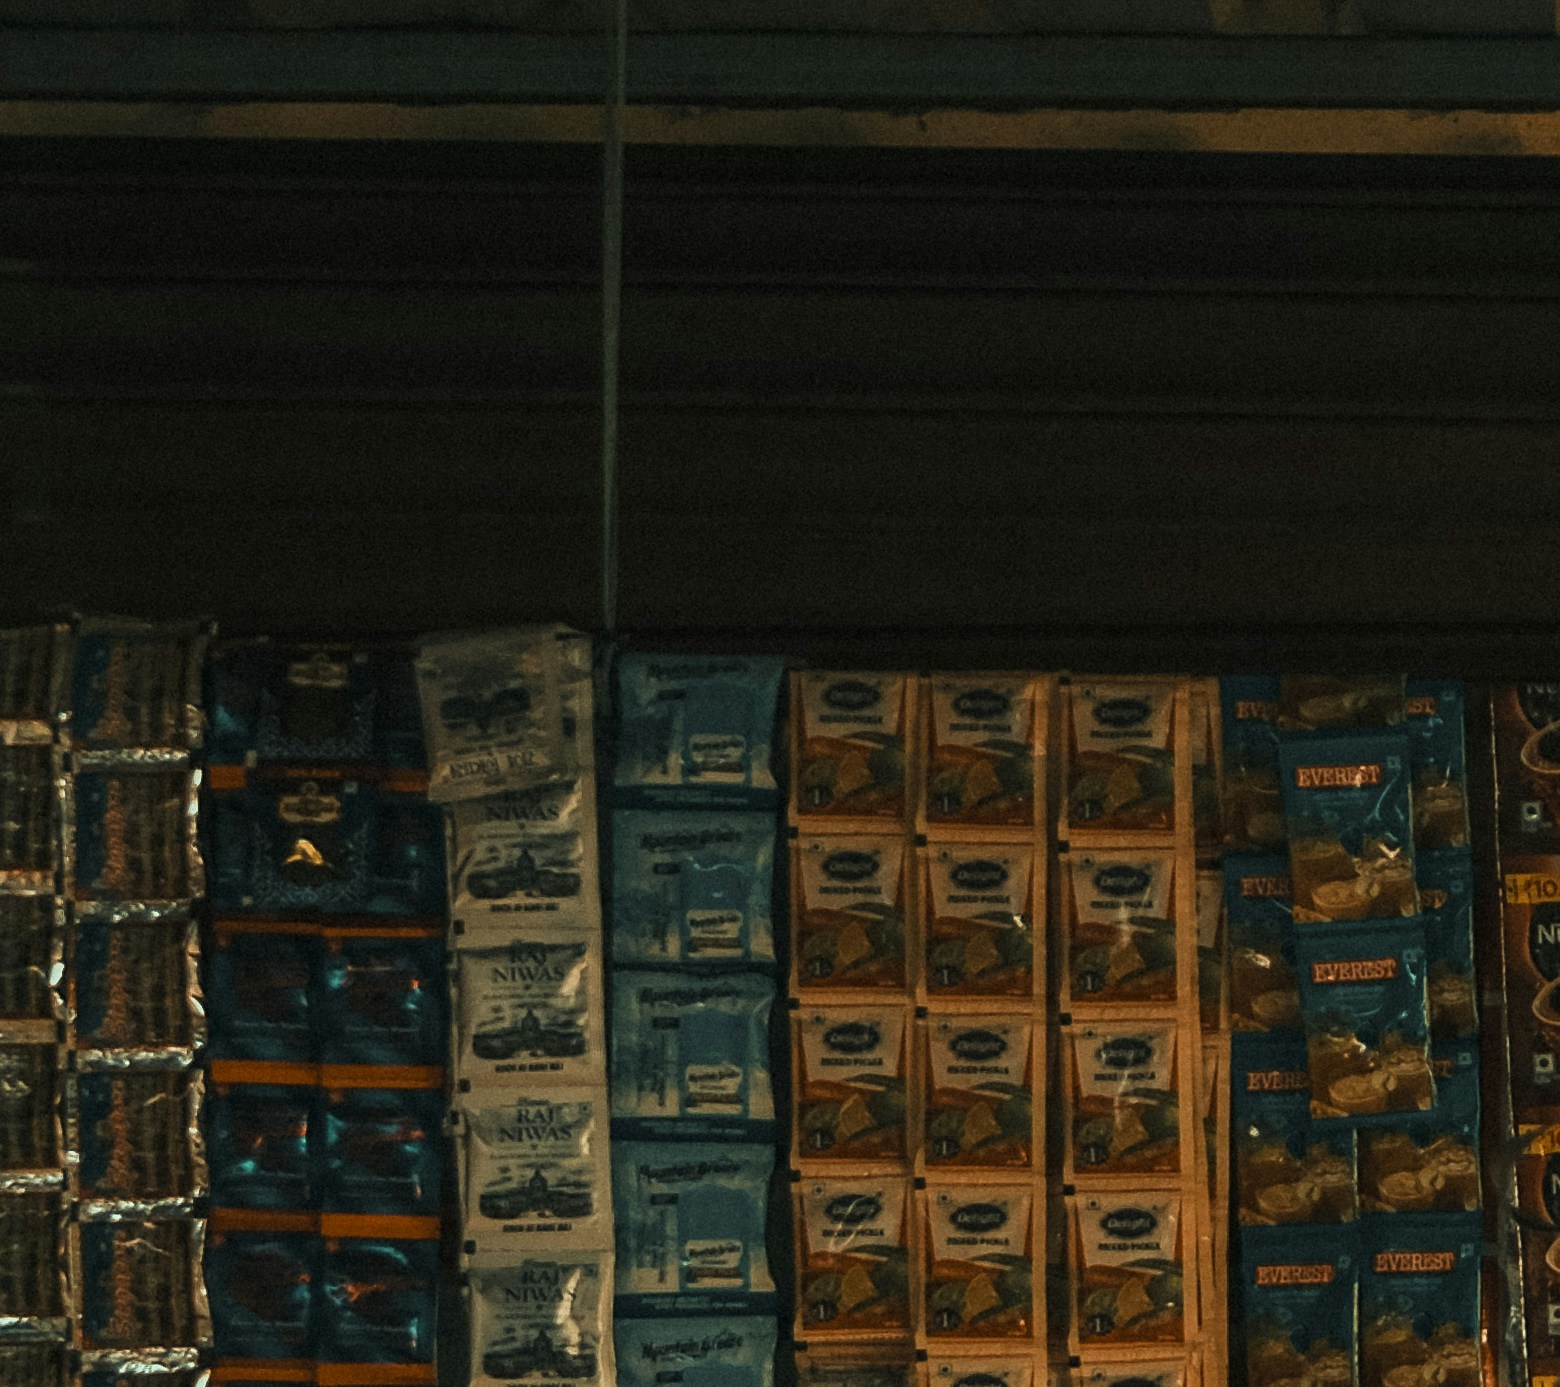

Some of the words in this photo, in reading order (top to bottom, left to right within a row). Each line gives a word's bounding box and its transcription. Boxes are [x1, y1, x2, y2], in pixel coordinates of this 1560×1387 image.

[1298, 765, 1379, 787] EVEREST
[1314, 960, 1396, 982] EVEREST
[1376, 1253, 1454, 1272] EVEREST
[1257, 1265, 1332, 1284] EVEREST
